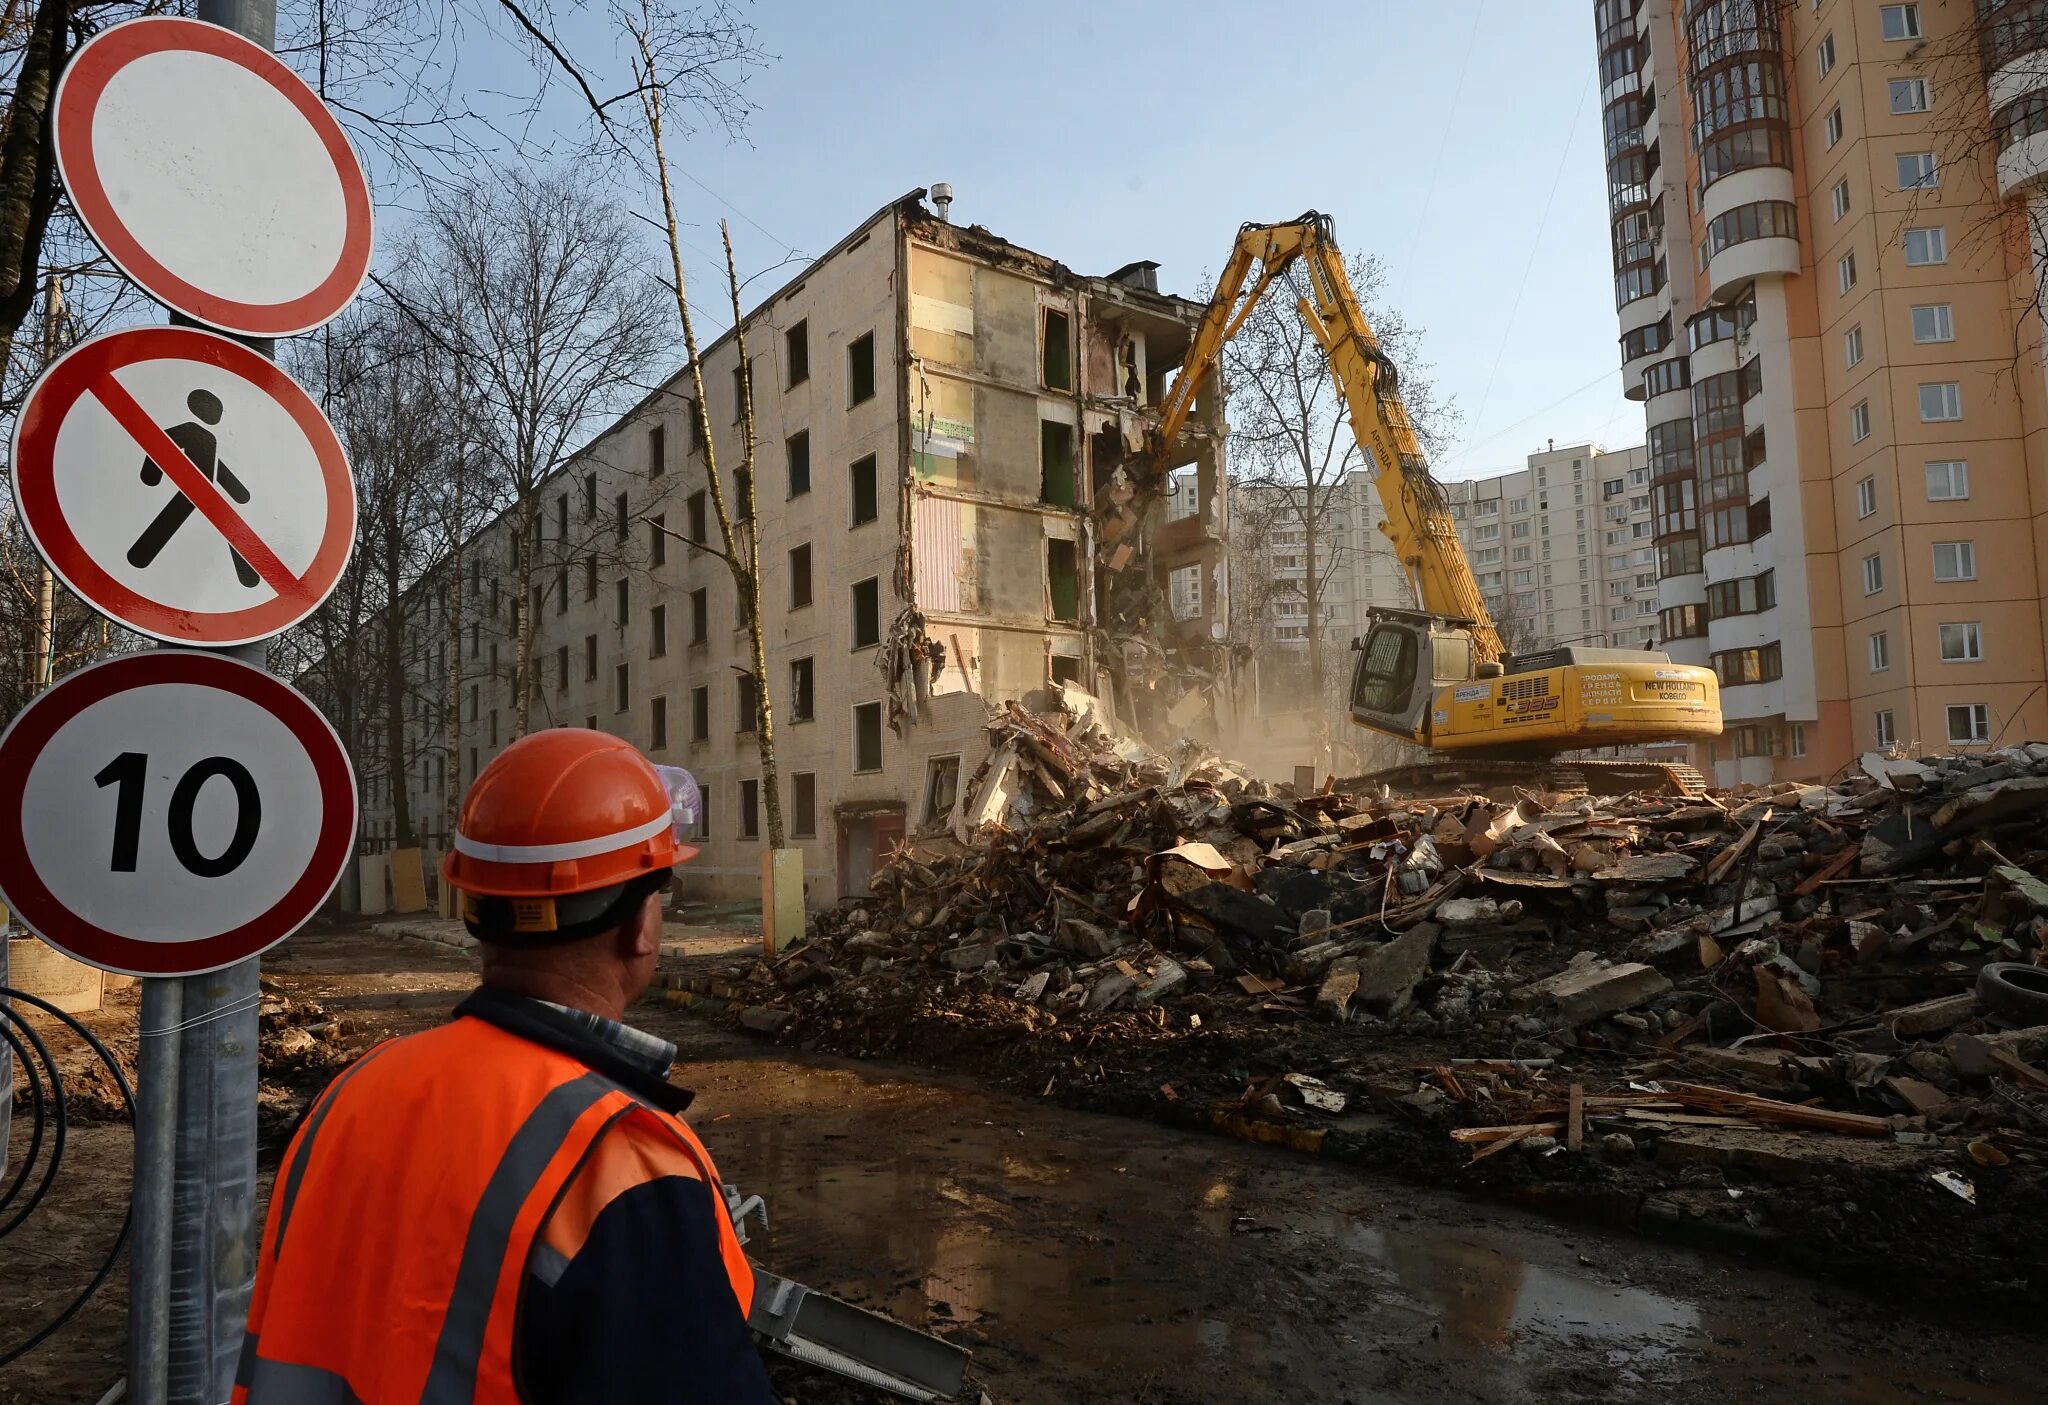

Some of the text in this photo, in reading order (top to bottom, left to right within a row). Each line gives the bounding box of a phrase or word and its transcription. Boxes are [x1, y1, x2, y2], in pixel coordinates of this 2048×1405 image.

[1313, 256, 1333, 304] NEW HOLLAND
[1371, 429, 1392, 471] АРЕНДА
[1645, 681, 1696, 691] NEW HOLLAND
[1456, 689, 1480, 698] АРЕНДА
[1659, 692, 1687, 700] KOBELCO
[1582, 697, 1623, 705] СЕРВИС
[94, 752, 262, 878] 10
